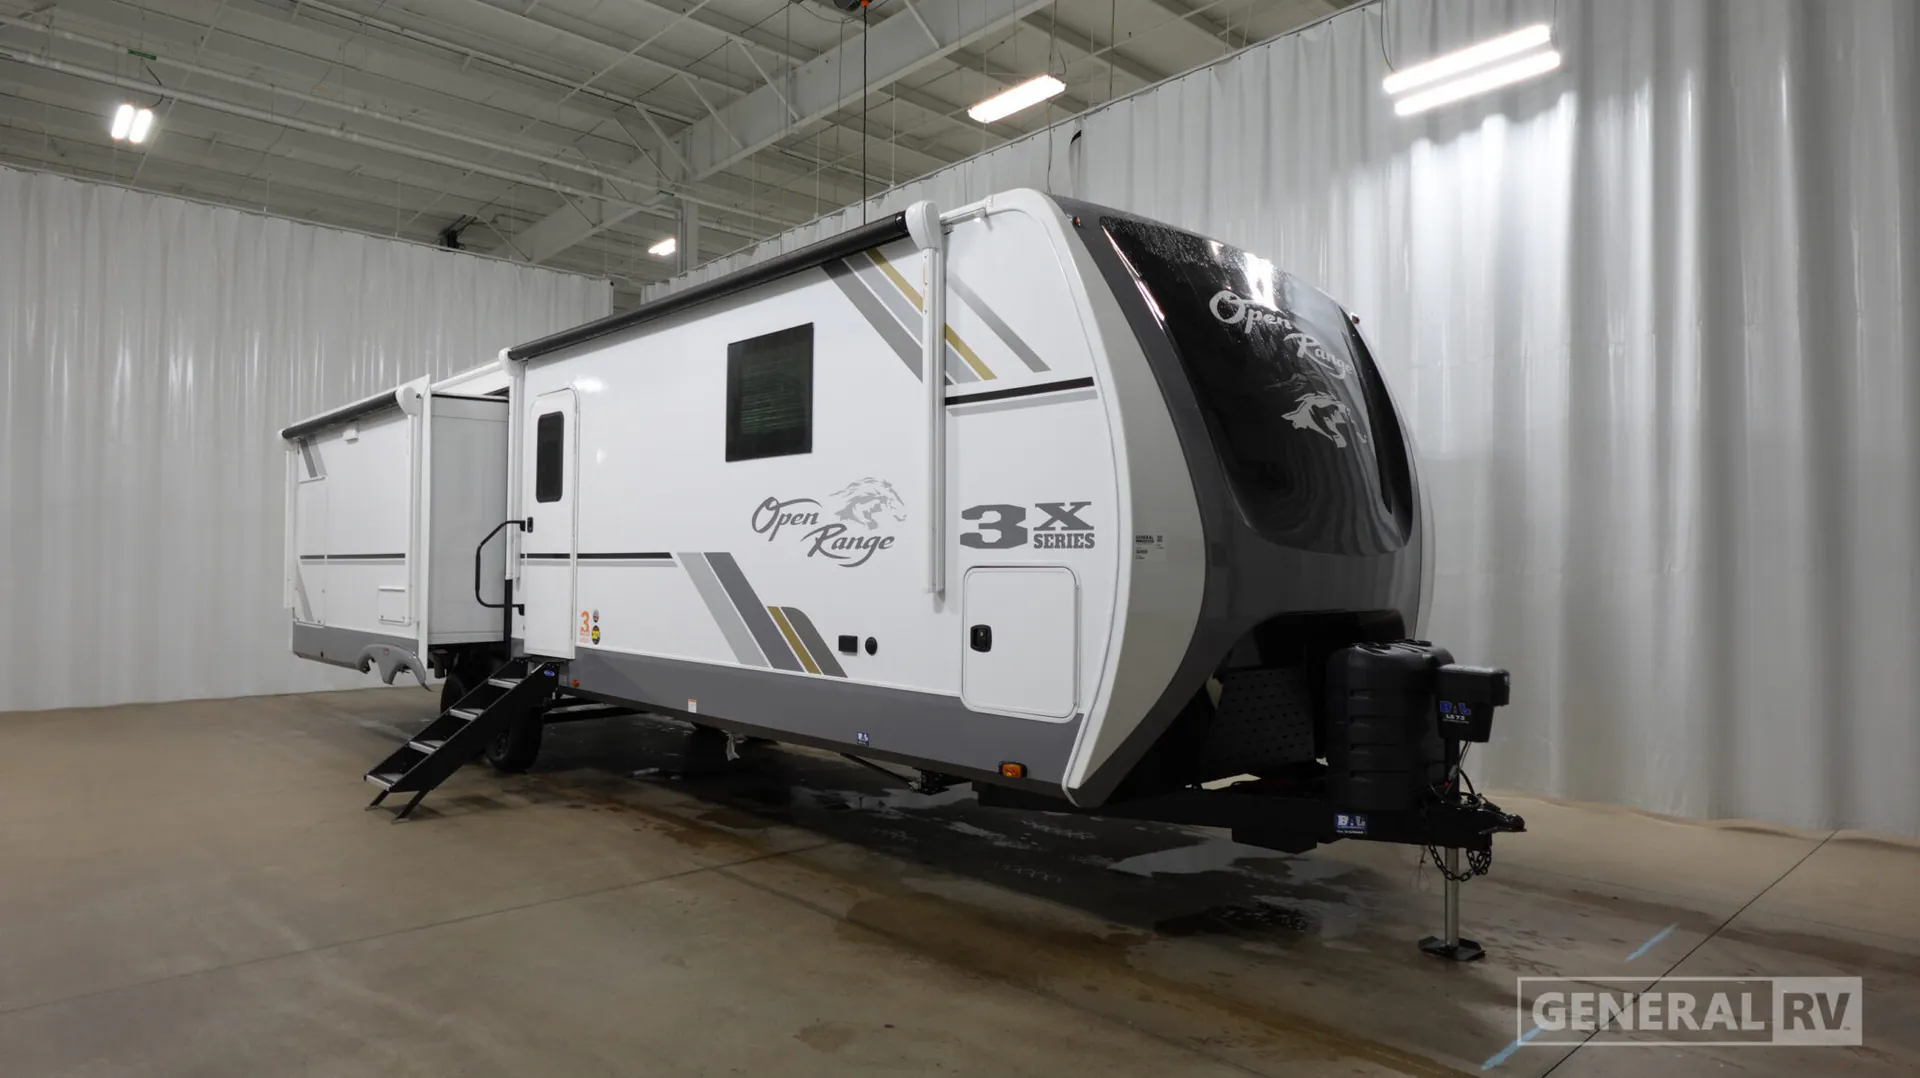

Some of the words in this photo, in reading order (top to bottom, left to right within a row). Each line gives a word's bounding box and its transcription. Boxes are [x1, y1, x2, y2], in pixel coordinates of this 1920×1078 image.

[1209, 290, 1292, 334] Open
[1284, 332, 1353, 380] Range
[751, 496, 823, 542] Open
[960, 504, 1028, 549] 3
[1033, 533, 1095, 549] SERIES
[800, 523, 895, 567] Range
[580, 610, 590, 632] 3
